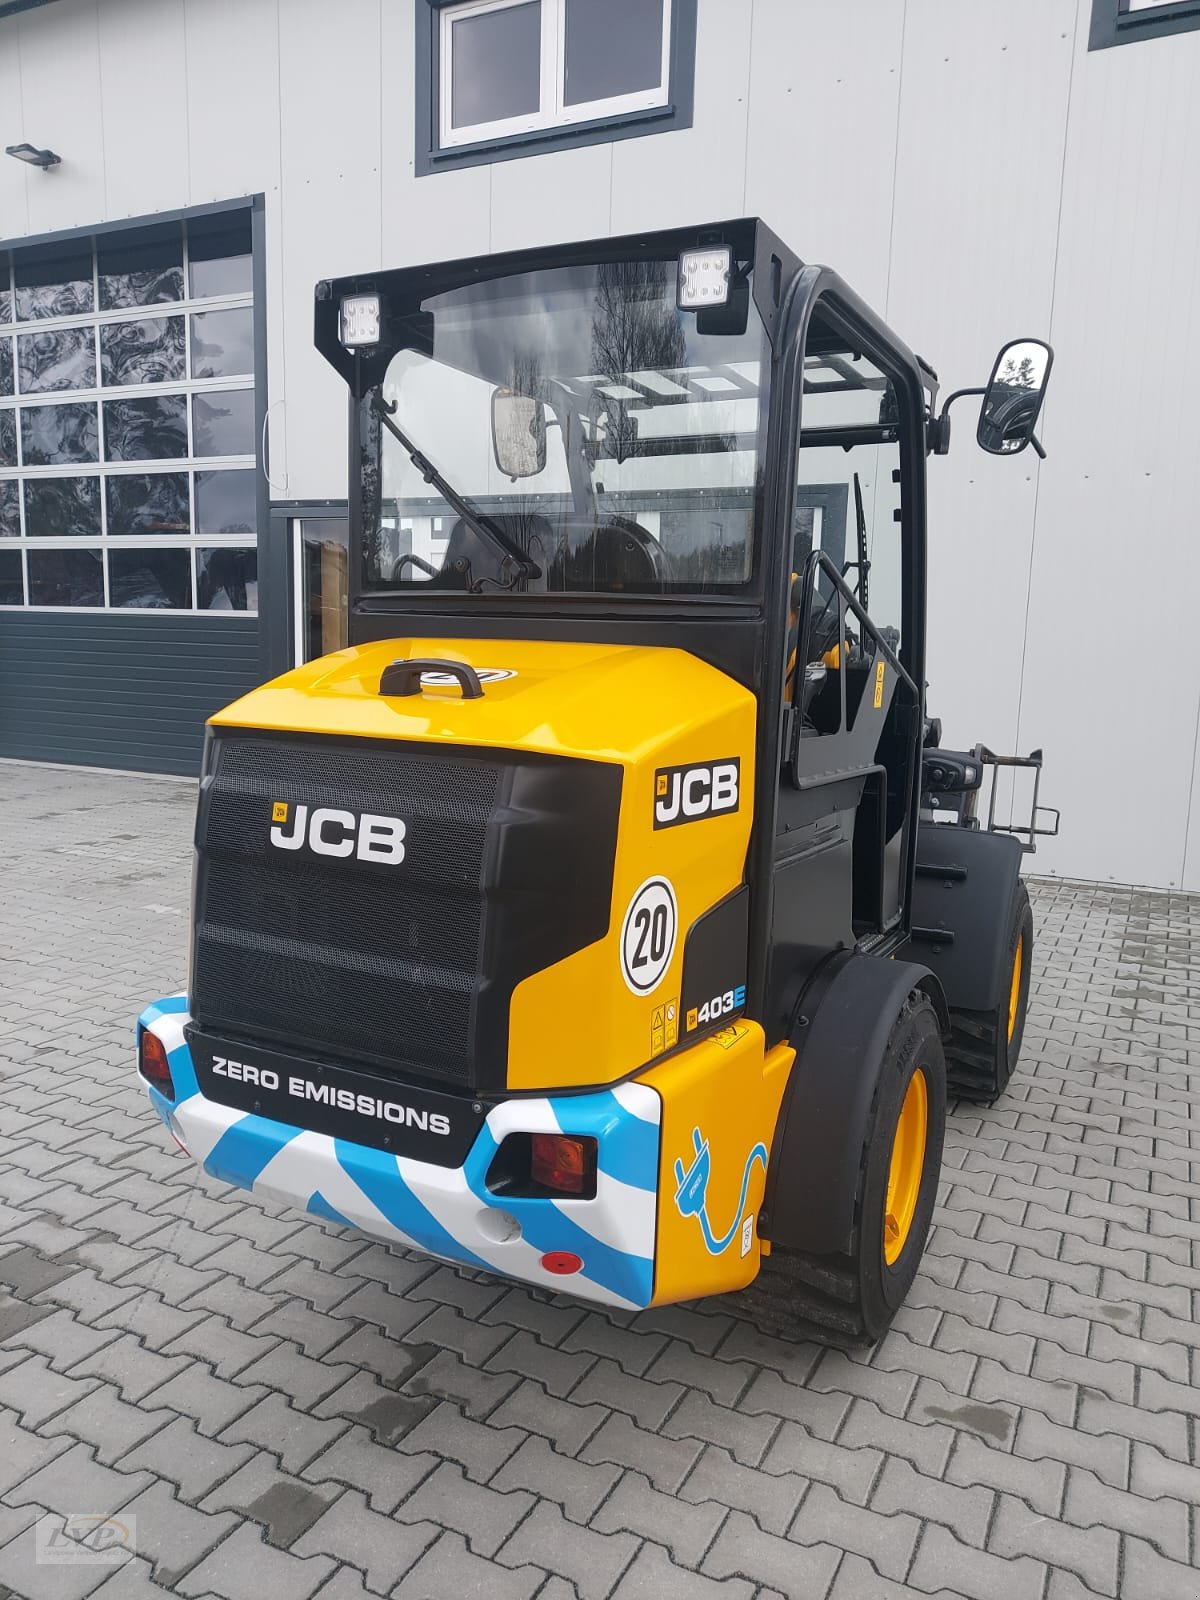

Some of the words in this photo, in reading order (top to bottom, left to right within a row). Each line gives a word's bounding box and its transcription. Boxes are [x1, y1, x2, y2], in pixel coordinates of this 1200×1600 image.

[656, 764, 738, 822] JCB
[270, 804, 406, 865] JCB
[632, 904, 667, 969] 20
[698, 985, 746, 1023] 403E
[212, 1055, 279, 1090] ZERO
[289, 1076, 450, 1136] EMISSIONS
